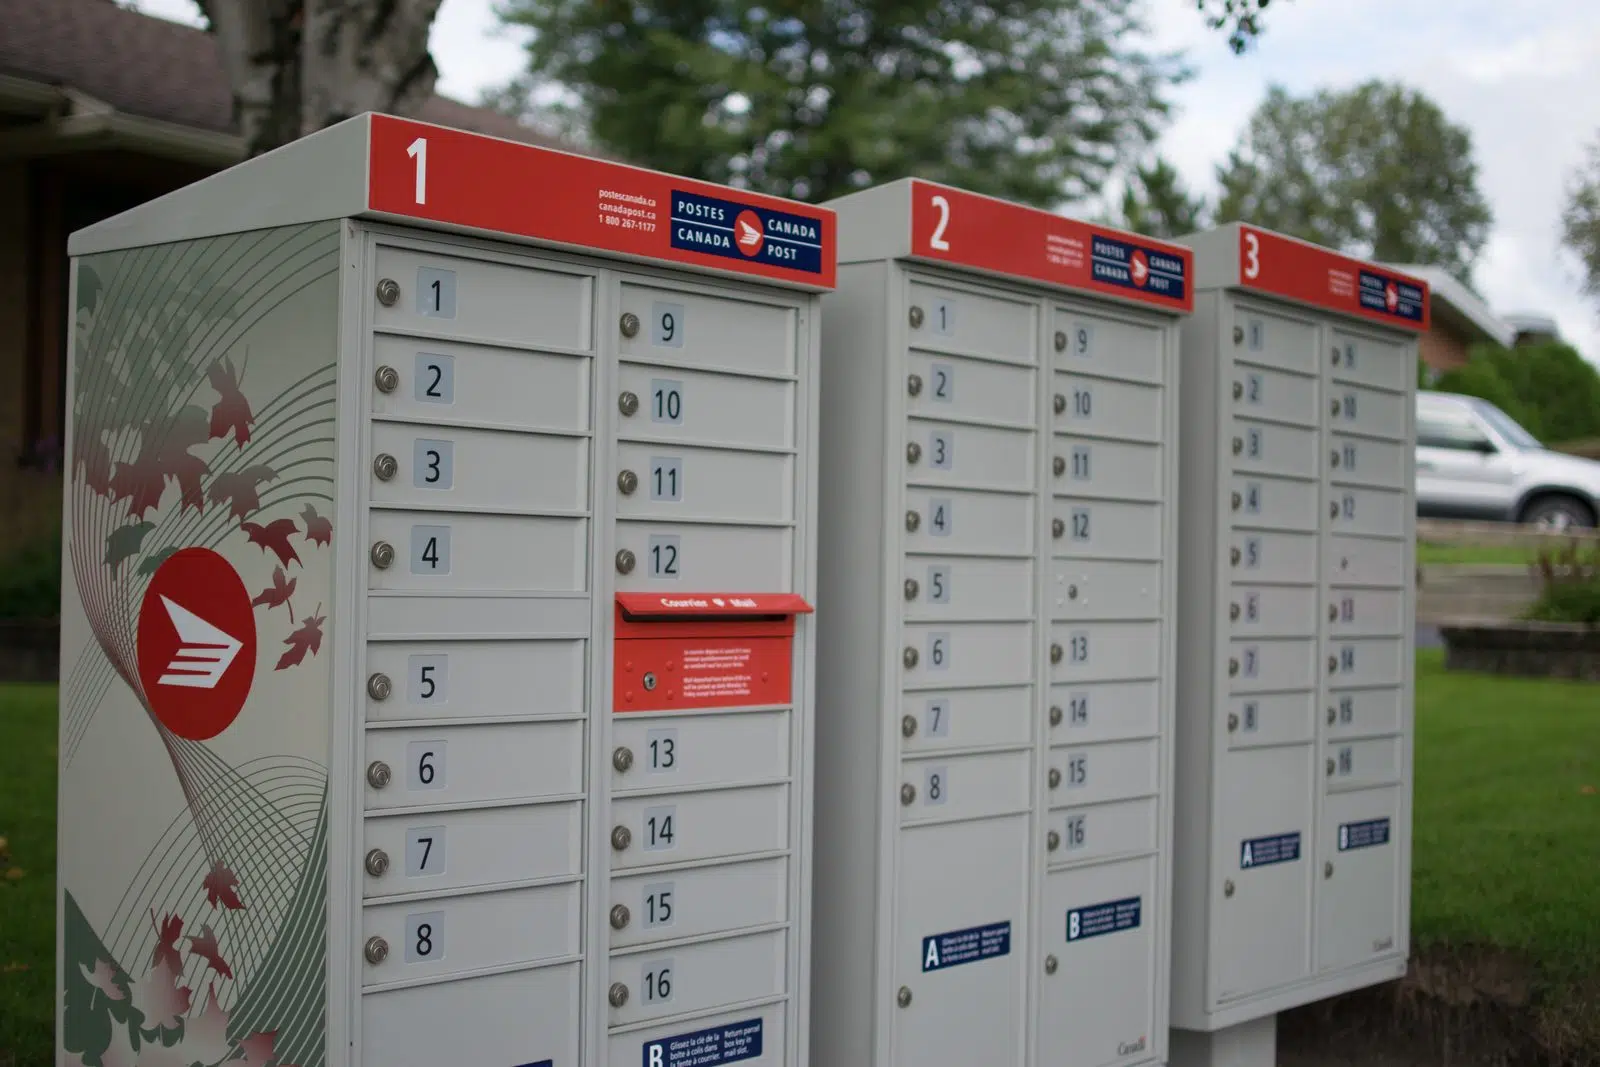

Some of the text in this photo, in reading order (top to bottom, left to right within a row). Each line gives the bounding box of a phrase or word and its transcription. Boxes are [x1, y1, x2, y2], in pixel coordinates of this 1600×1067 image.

[406, 138, 427, 204] 1
[599, 189, 656, 206] postescanada.ca
[678, 200, 725, 221] POSTES
[599, 202, 656, 220] canadapost.ca
[599, 214, 656, 232] 1 800 267-1177
[930, 195, 949, 250] 2
[678, 228, 730, 248] CANADA
[767, 219, 816, 239] CANADA
[768, 244, 797, 260] POST
[1095, 242, 1125, 259] POSTES
[1149, 255, 1181, 272] CANADA
[1244, 233, 1260, 279] 3
[1094, 264, 1128, 280] CANADA
[1150, 277, 1170, 290] POST
[431, 279, 441, 311] 1
[661, 312, 675, 342] 9
[939, 305, 946, 331] 1
[1078, 329, 1088, 353] 9
[425, 364, 442, 397] 2
[936, 371, 947, 397] 2
[654, 389, 681, 419] 10
[1074, 391, 1091, 415] 10
[935, 438, 945, 465] 3
[1073, 453, 1088, 476] 11
[424, 450, 441, 483] 3
[654, 466, 677, 496] 11
[934, 505, 944, 531] 4
[1072, 513, 1089, 538] 12
[421, 537, 439, 569] 4
[652, 545, 677, 574] 12
[933, 573, 943, 599] 5
[933, 639, 943, 665] 6
[1071, 636, 1088, 661] 13
[420, 666, 435, 699] 5
[931, 706, 942, 732] 7
[1070, 699, 1087, 723] 14
[649, 738, 675, 769] 13
[419, 751, 435, 785] 6
[1069, 759, 1086, 784] 15
[930, 774, 941, 800] 8
[647, 815, 674, 846] 14
[1068, 820, 1084, 845] 16
[417, 837, 433, 870] 7
[1242, 841, 1253, 867] A
[645, 892, 672, 924] 15
[1069, 911, 1080, 939] B
[415, 923, 433, 956] 8
[925, 939, 940, 968] A
[645, 969, 671, 1000] 16
[670, 1041, 689, 1050] Glissez
[714, 1033, 720, 1041] la
[724, 1029, 743, 1038] Return
[724, 1040, 735, 1048] box
[735, 1038, 745, 1046] key
[649, 1044, 663, 1067] B
[686, 1049, 690, 1057] à
[691, 1047, 704, 1056] colis
[704, 1043, 718, 1052] dans
[692, 1057, 697, 1065] à
[724, 1048, 736, 1058] mail
